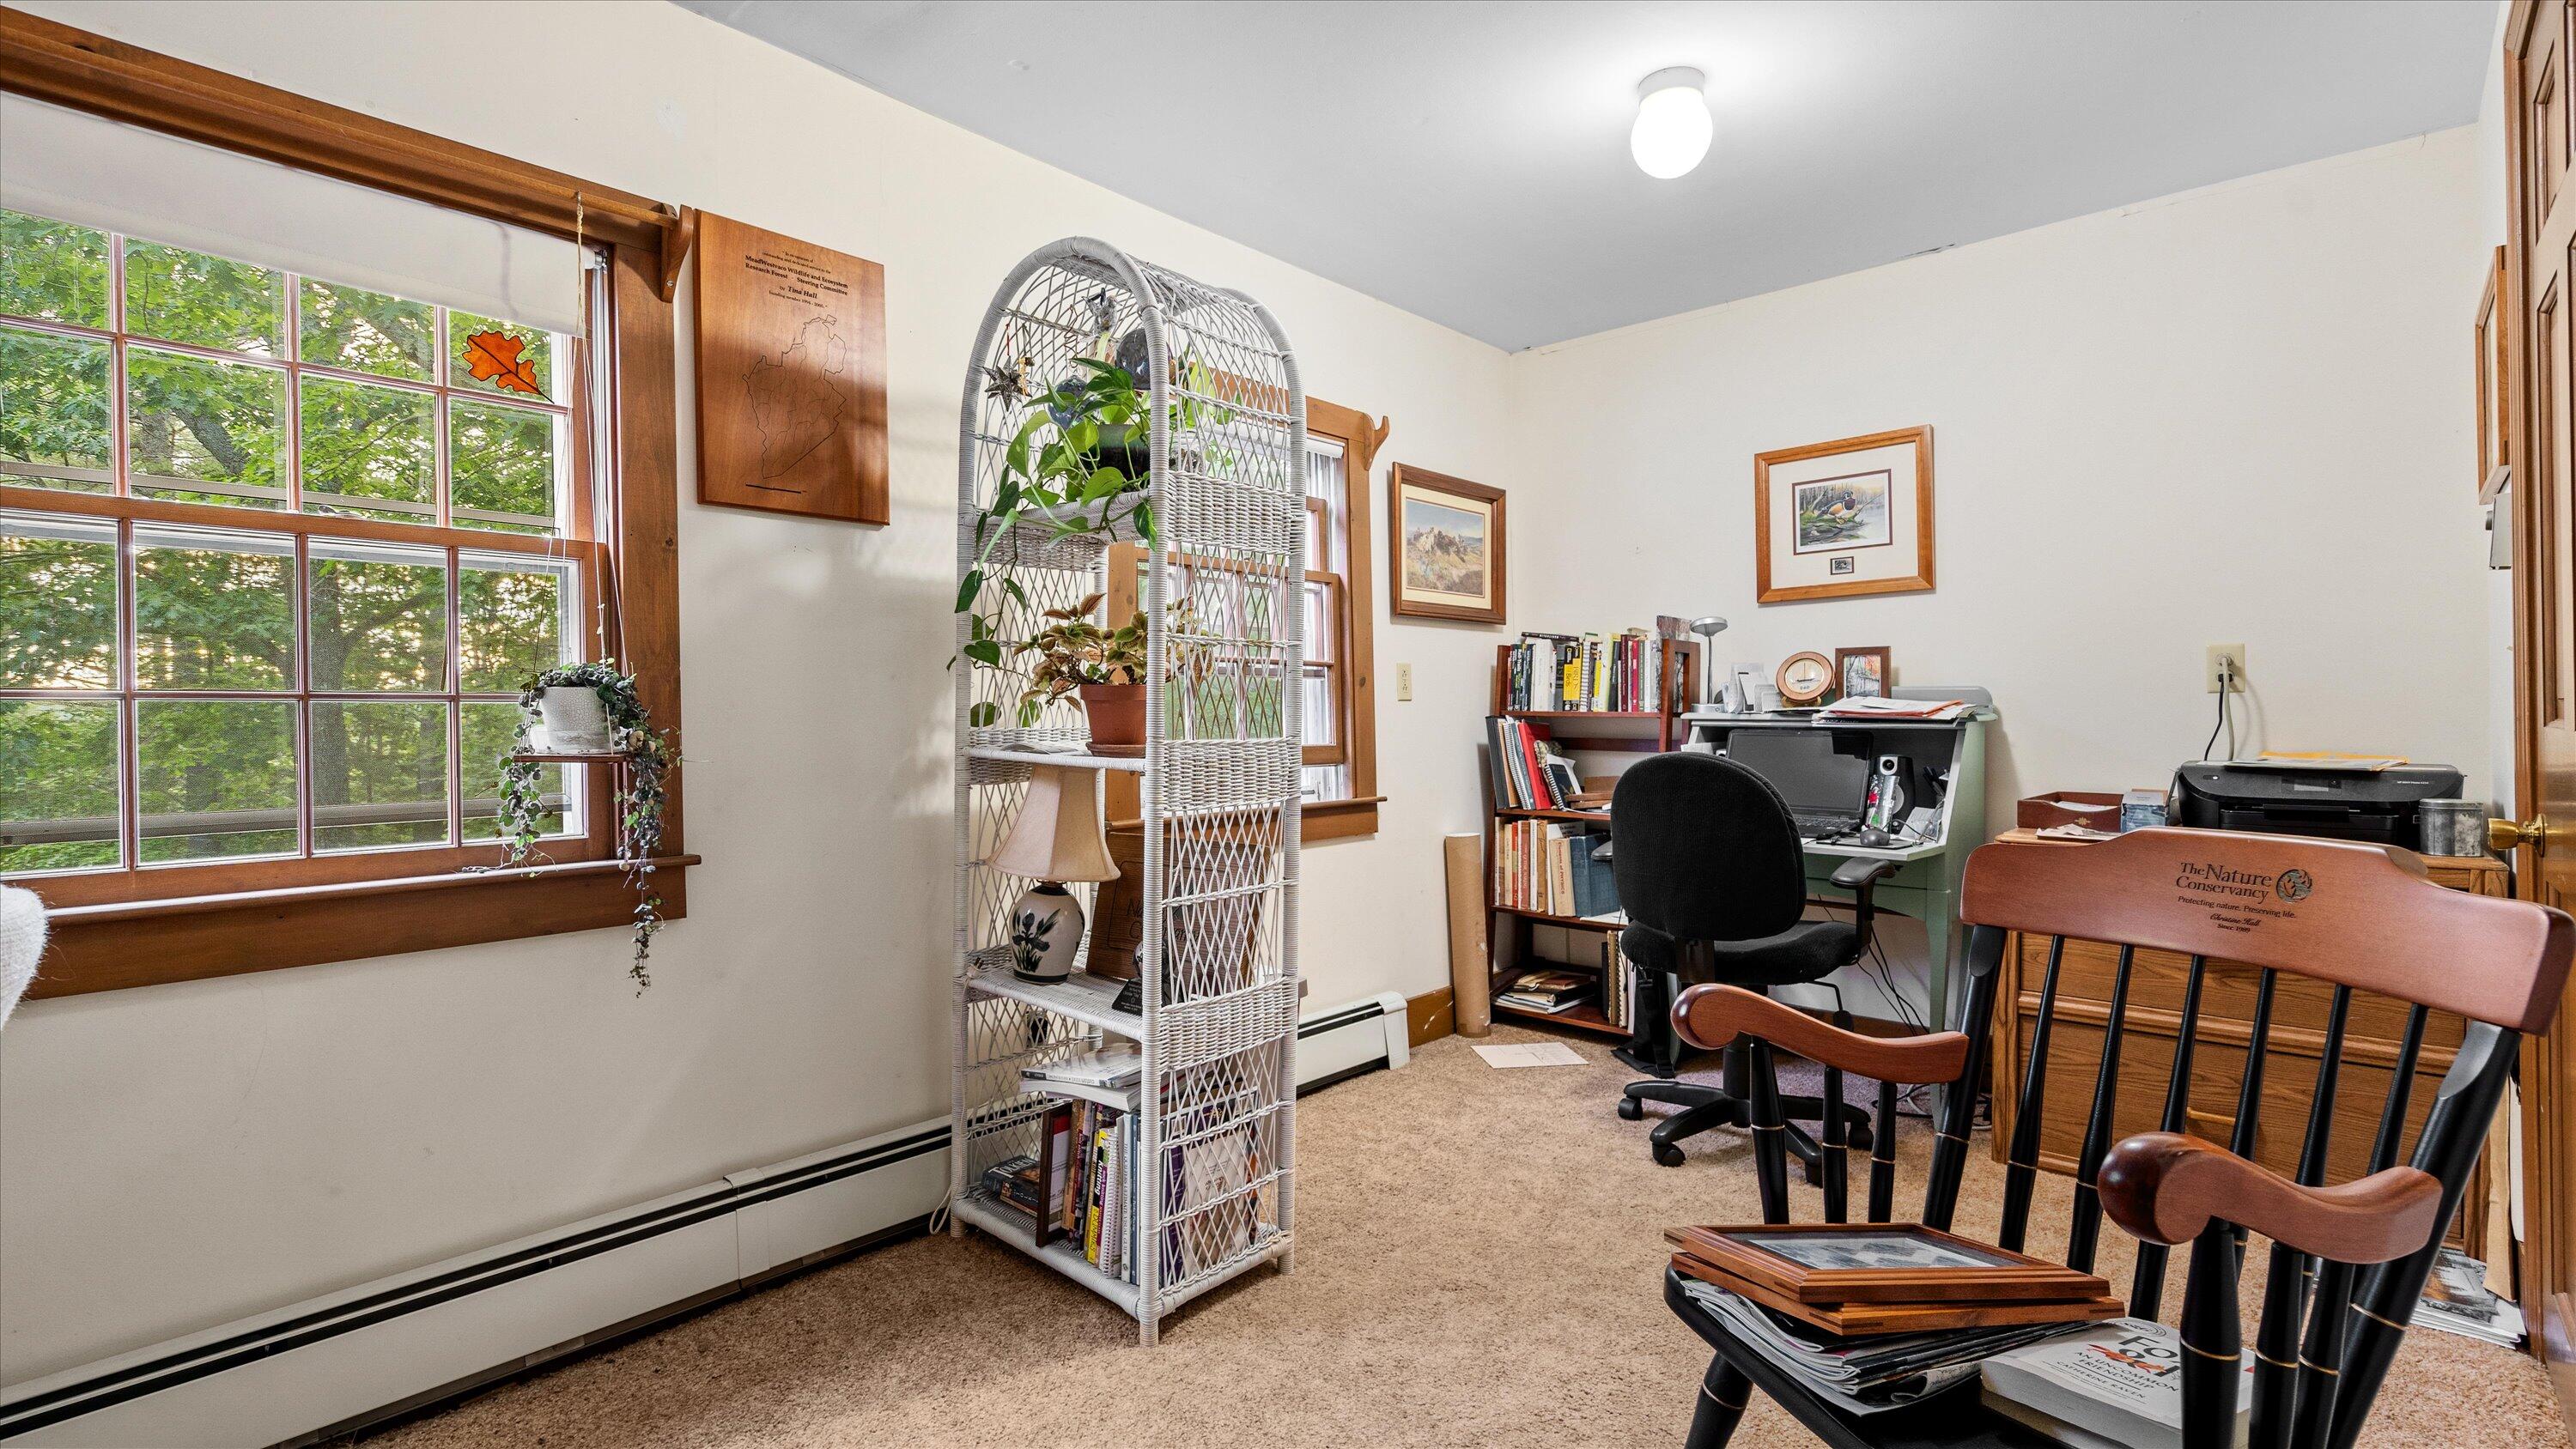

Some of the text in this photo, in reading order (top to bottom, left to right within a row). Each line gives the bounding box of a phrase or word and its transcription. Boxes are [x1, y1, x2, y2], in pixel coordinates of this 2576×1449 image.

[745, 254, 787, 271] MeadWestvaco
[787, 266, 811, 278] Wildlife
[821, 276, 848, 288] Ecosystem
[745, 262, 848, 295] Research Forest Steering Committee
[787, 285, 802, 294] Tina
[803, 290, 817, 299] Hall
[2176, 876, 2269, 904] Conservancy
[2181, 862, 2272, 888] The Nature
[2178, 895, 2296, 919] Protecting nature. Preserving life.
[2210, 912, 2261, 926] Christine Hall
[988, 1157, 1037, 1179] TOLKIEN
[1094, 1159, 1103, 1196] Knitting
[1089, 1213, 1099, 1252] DUMMIES
[2057, 1361, 2146, 1398] CATHERINE RAVEN
[2079, 1359, 2154, 1389] FRIENDSHIP
[2095, 1356, 2180, 1391] UNCOMMON
